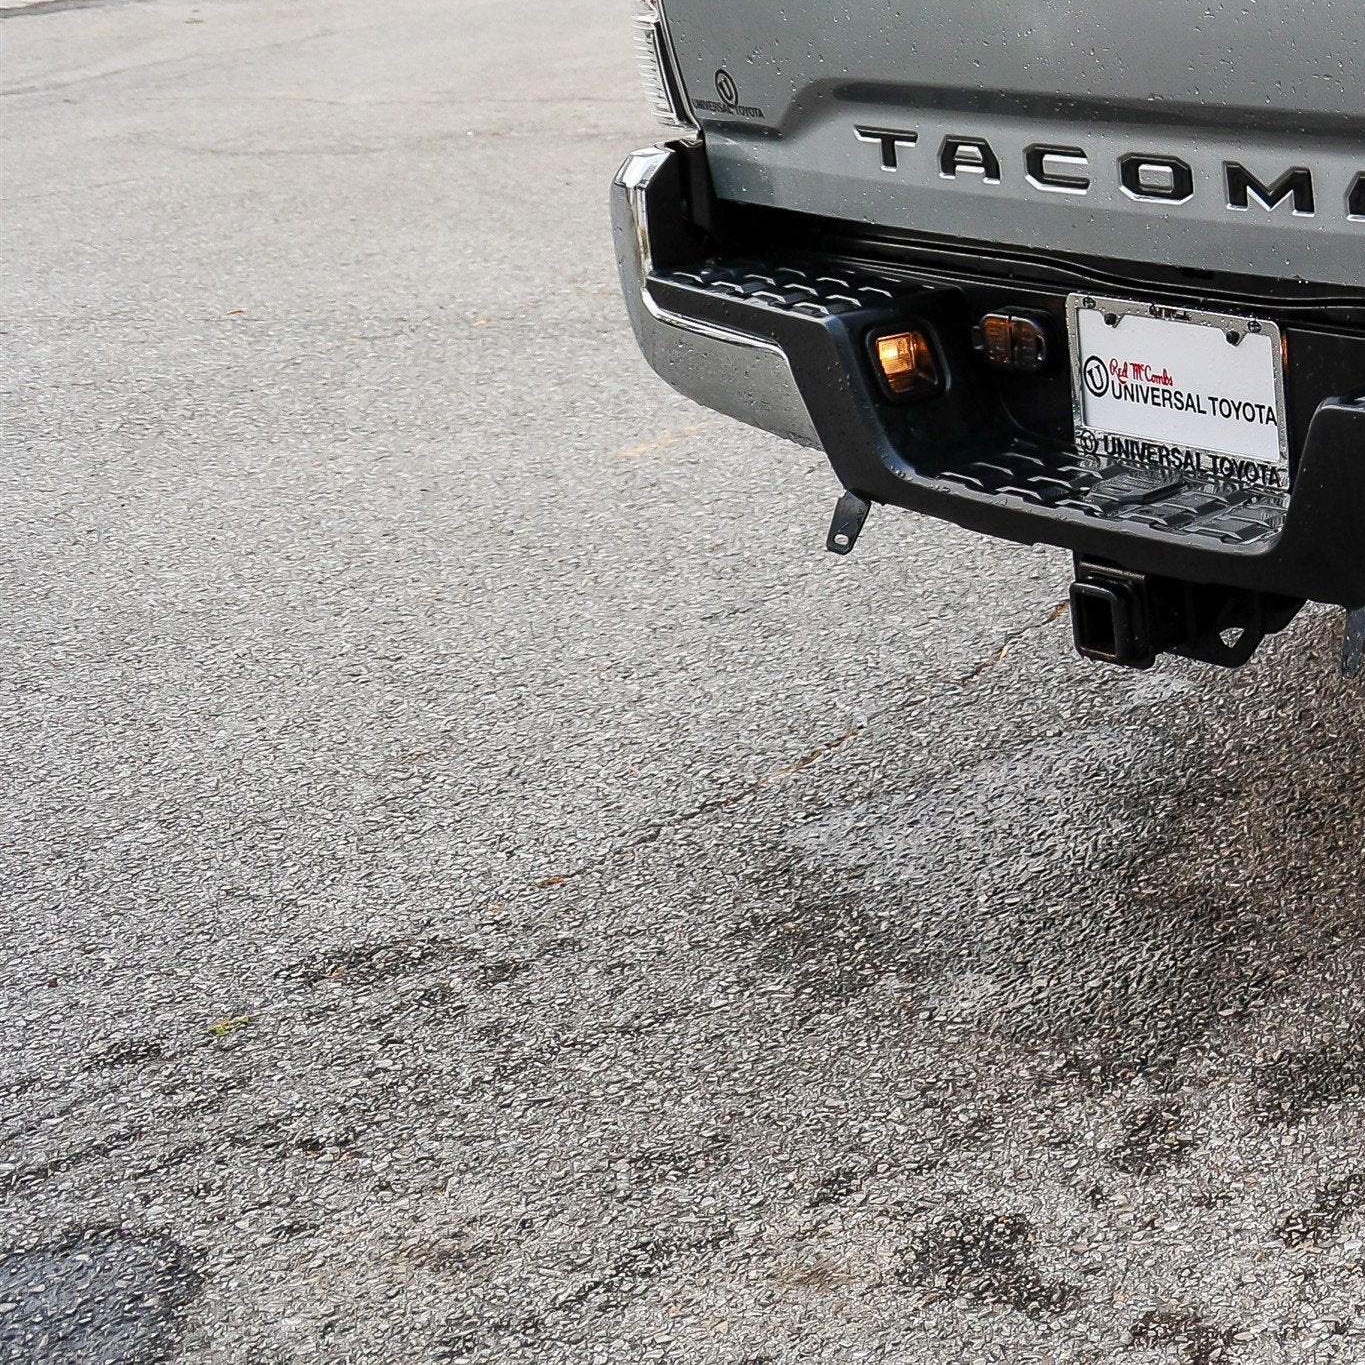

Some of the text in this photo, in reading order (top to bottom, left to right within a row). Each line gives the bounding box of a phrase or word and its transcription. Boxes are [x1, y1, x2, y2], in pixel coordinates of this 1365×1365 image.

[1109, 357, 1128, 385] Red
[1111, 379, 1278, 427] UNIVERSAL TOYOTA
[1101, 434, 1283, 487] UNIVERSAL TOYOTA
